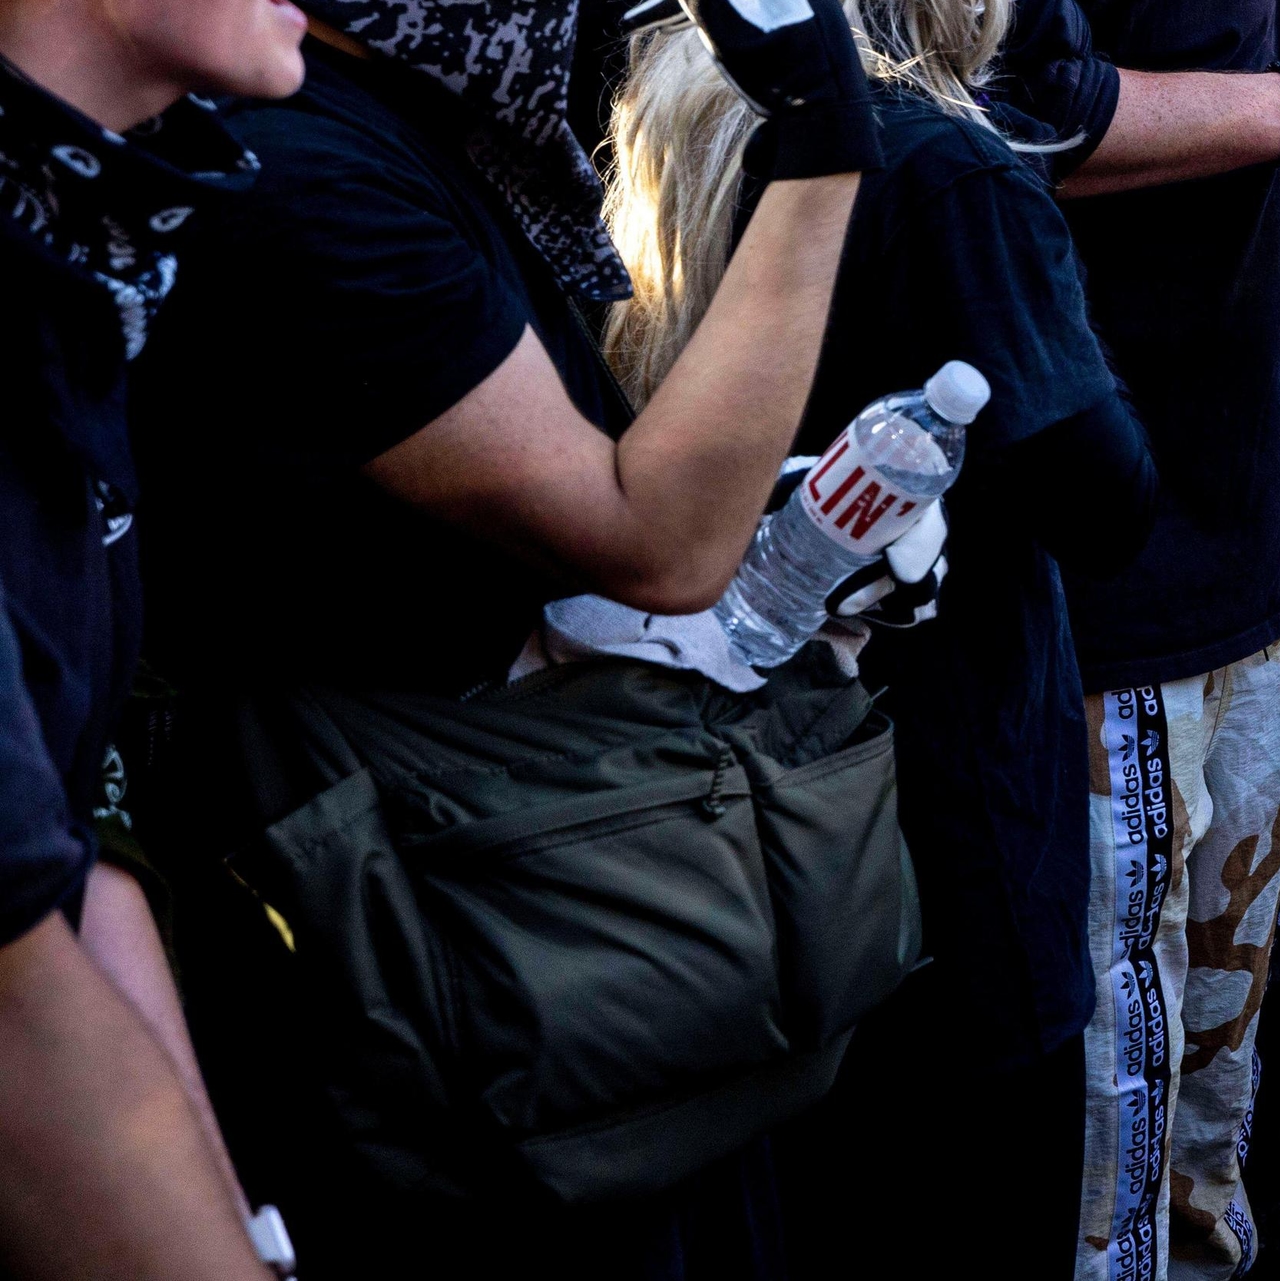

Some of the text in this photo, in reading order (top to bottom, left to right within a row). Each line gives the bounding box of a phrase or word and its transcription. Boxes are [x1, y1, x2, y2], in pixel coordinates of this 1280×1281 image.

[808, 431, 917, 541] LIN'
[1119, 763, 1144, 845] adidas
[1145, 757, 1168, 839] adidas
[1123, 999, 1143, 1076] adidas
[1147, 988, 1165, 1067] adidas
[1125, 1117, 1146, 1195] adidas
